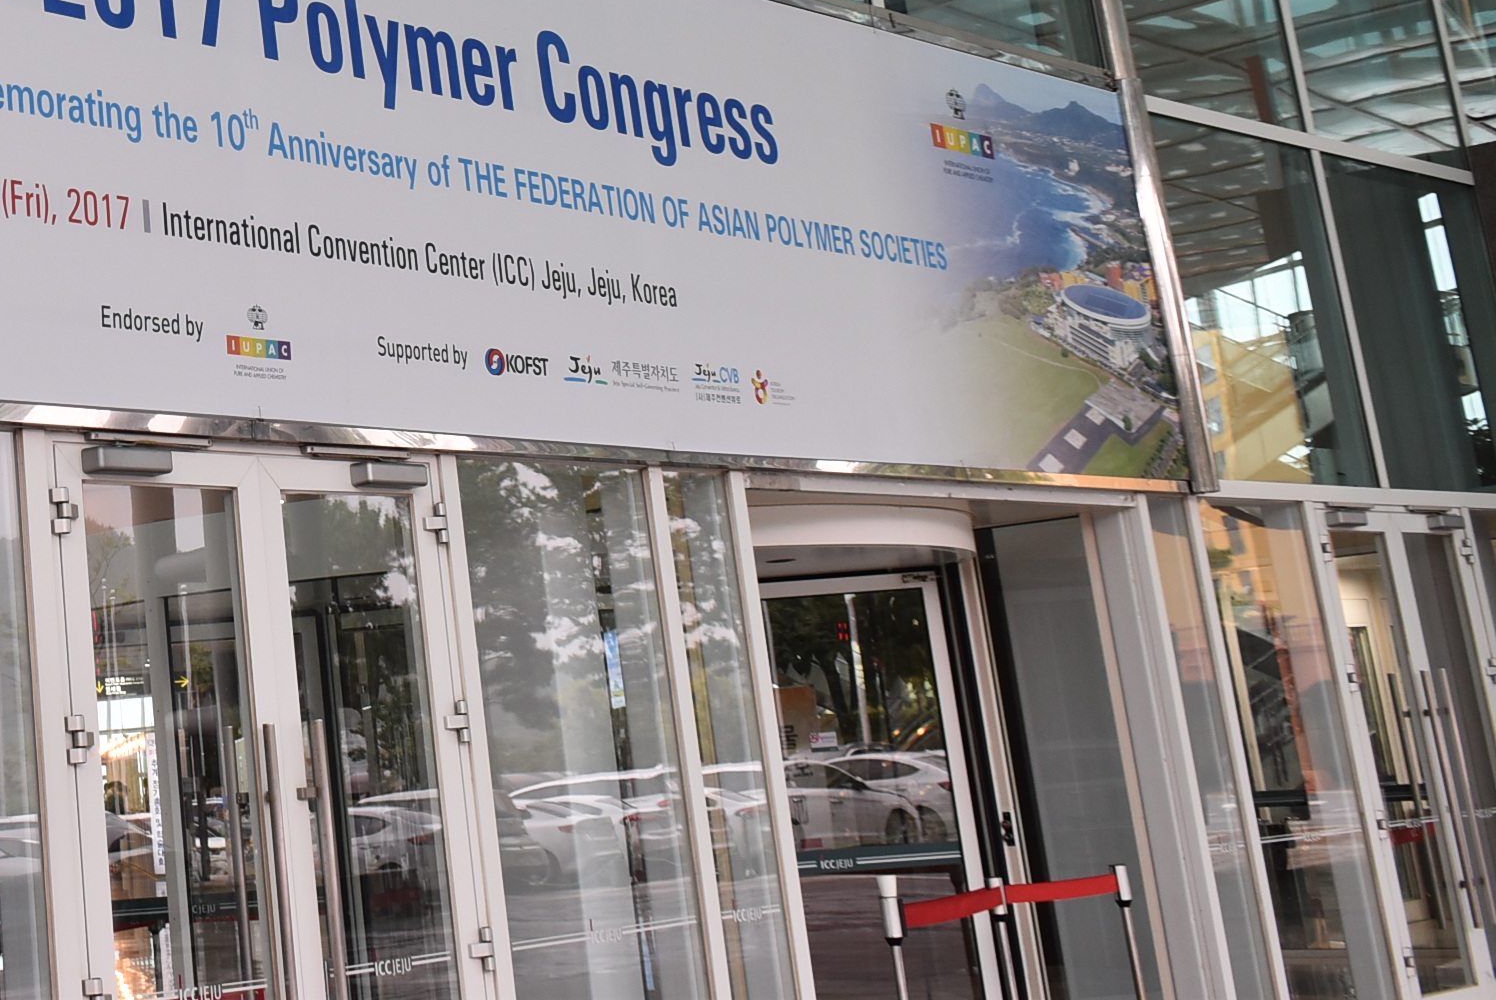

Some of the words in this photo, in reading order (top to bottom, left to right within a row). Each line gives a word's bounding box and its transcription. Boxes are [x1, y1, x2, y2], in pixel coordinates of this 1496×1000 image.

[537, 31, 778, 166] Congress
[934, 128, 992, 155] IUPAC
[152, 102, 197, 143] the
[211, 109, 258, 151] 10th
[268, 122, 417, 189] Anniversary
[428, 155, 450, 187] of
[458, 158, 507, 198] THE
[514, 168, 655, 224] FEDERATION
[663, 196, 689, 228] OF
[699, 203, 760, 240] ASIAN
[765, 214, 855, 255] POLYMER
[860, 230, 947, 270] SOCIETIES
[2, 179, 56, 225] (Fri),
[67, 189, 129, 229] 2017
[163, 202, 300, 254] International
[308, 224, 418, 271] Convention
[425, 243, 485, 280] Center
[493, 253, 534, 291] (ICC)
[542, 261, 581, 299] Jeju,
[588, 267, 625, 305] Jeju,
[631, 273, 677, 307] Korea
[101, 305, 180, 334] Endorsed
[186, 314, 203, 342] by
[230, 339, 288, 357] IUPAC
[378, 336, 448, 364] Supported
[453, 344, 467, 370] by
[506, 354, 548, 377] KOFST
[568, 355, 601, 383] Jeju
[611, 360, 679, 382] 제주특별자치도
[695, 363, 716, 382] Jeju
[719, 367, 740, 384] CVB
